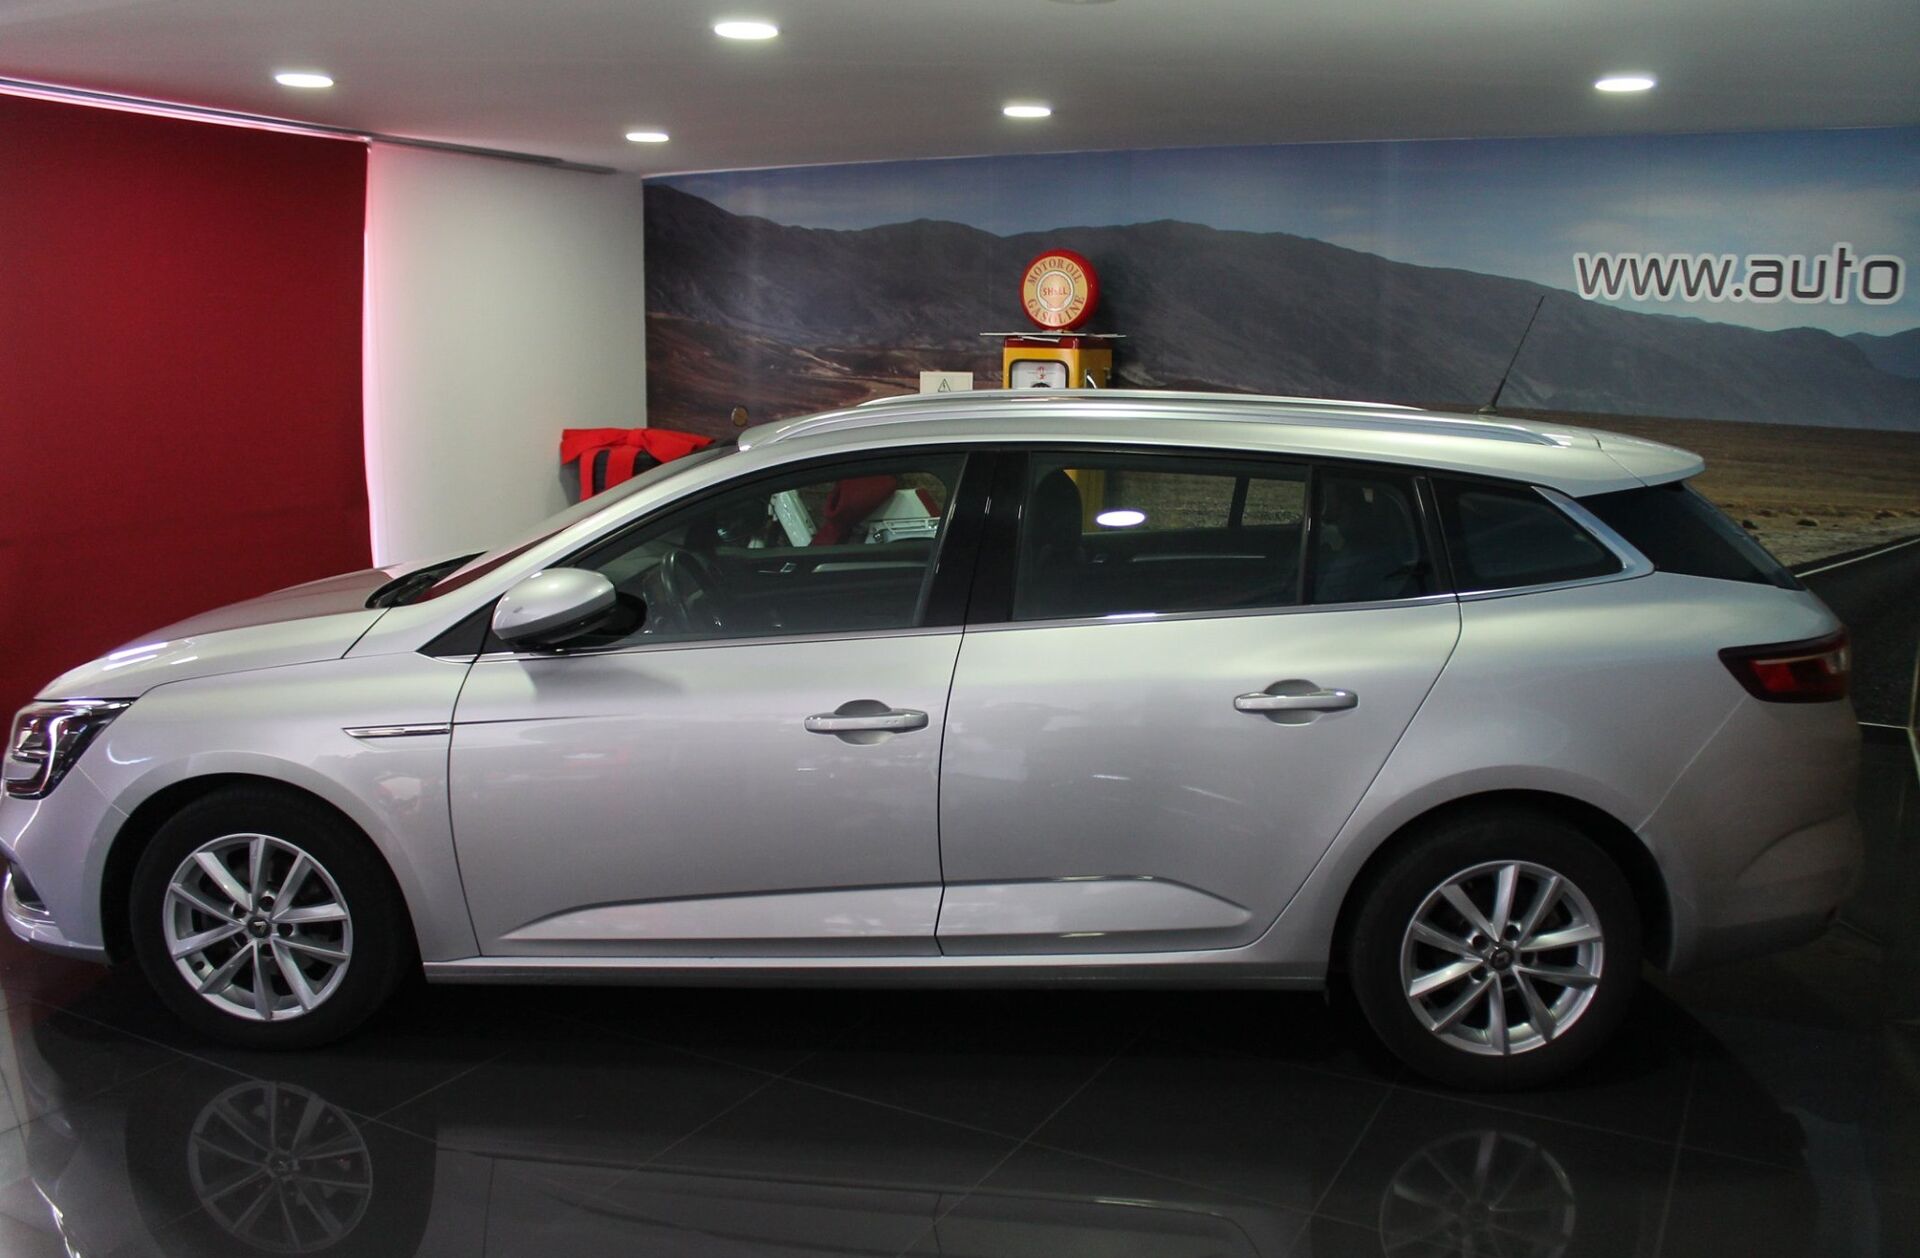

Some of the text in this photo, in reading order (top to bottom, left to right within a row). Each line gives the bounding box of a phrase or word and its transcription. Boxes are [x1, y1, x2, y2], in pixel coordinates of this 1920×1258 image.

[1028, 259, 1082, 285] MOTOR OIL
[1575, 245, 1903, 302] www.auto
[1028, 296, 1084, 323] GASOLINE
